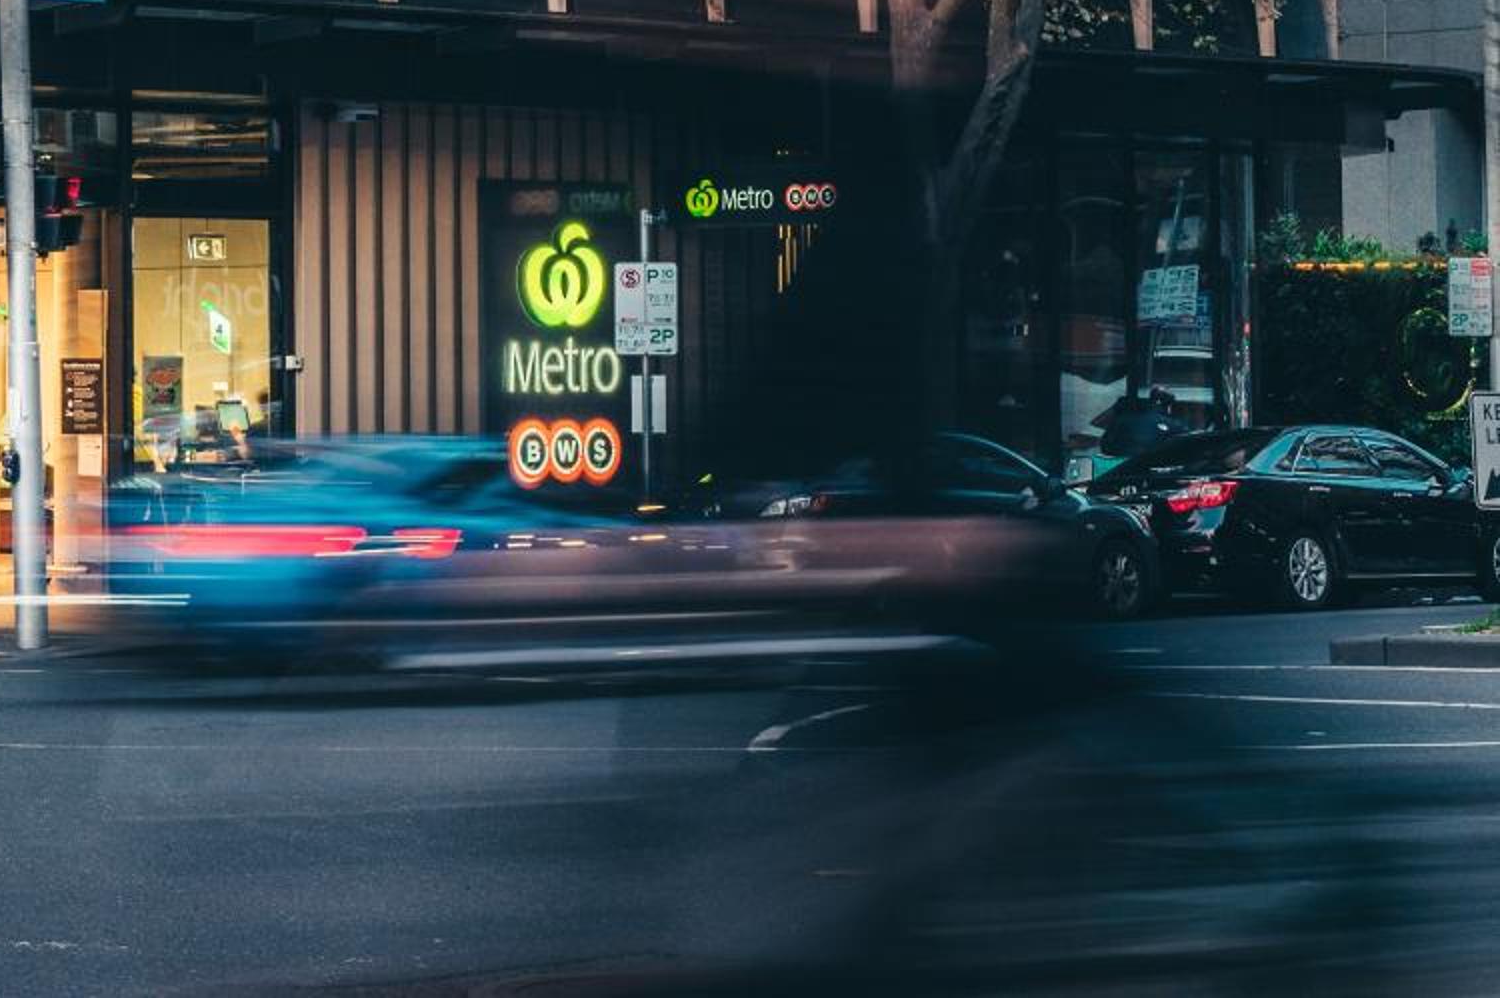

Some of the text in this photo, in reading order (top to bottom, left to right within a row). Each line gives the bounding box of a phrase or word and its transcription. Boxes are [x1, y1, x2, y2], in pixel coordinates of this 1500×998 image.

[721, 185, 774, 211] Metro
[647, 269, 659, 283] P
[649, 328, 675, 344] 2P
[509, 337, 622, 395] Metro
